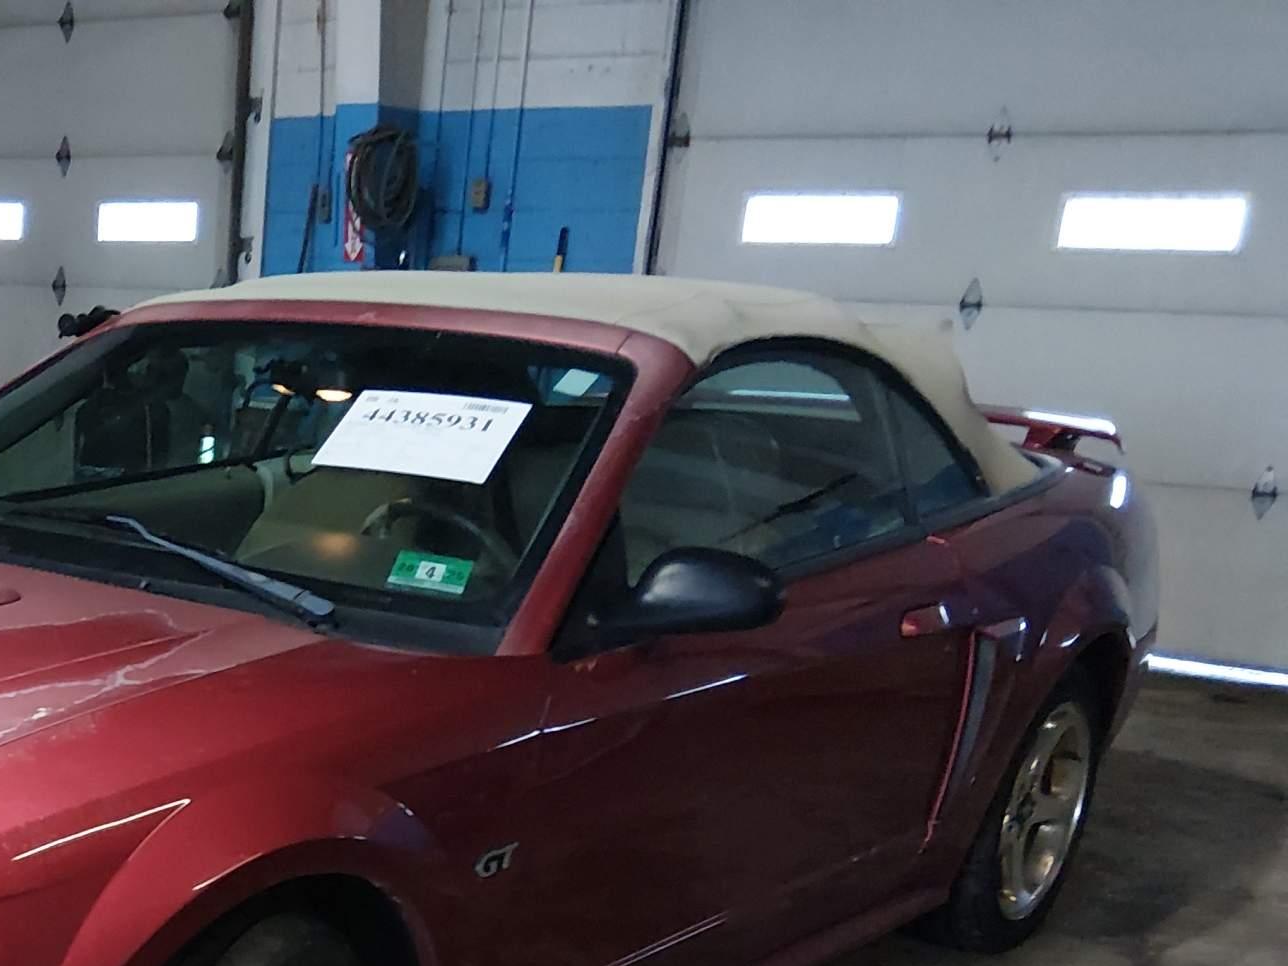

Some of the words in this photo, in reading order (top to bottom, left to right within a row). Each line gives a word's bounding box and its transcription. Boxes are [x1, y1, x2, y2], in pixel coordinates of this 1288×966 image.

[362, 407, 494, 432] 44385931
[425, 566, 437, 578] 4
[475, 842, 519, 878] GT
